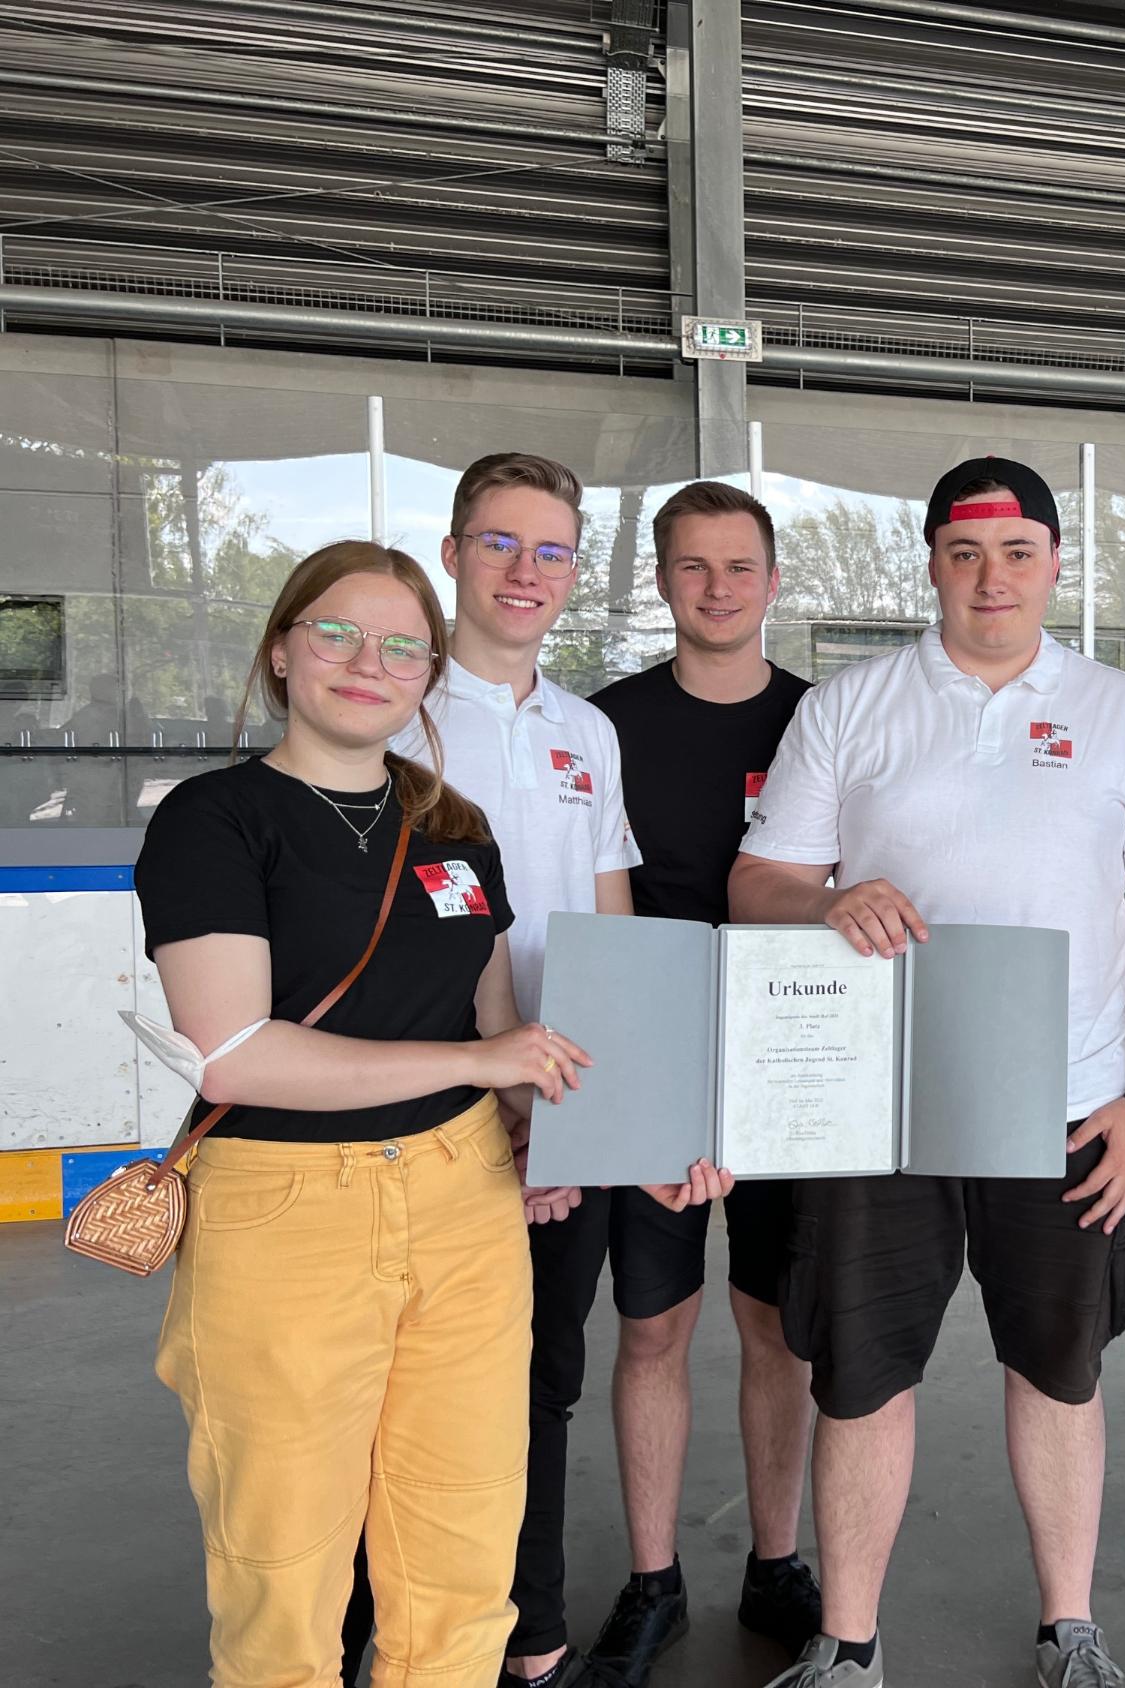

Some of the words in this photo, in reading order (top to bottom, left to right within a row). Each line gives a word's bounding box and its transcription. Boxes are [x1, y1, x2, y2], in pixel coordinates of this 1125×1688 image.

[1032, 759, 1068, 769] Bastian
[558, 794, 593, 807] Matthias
[444, 903, 458, 912] ST.
[768, 980, 848, 997] Urkunde
